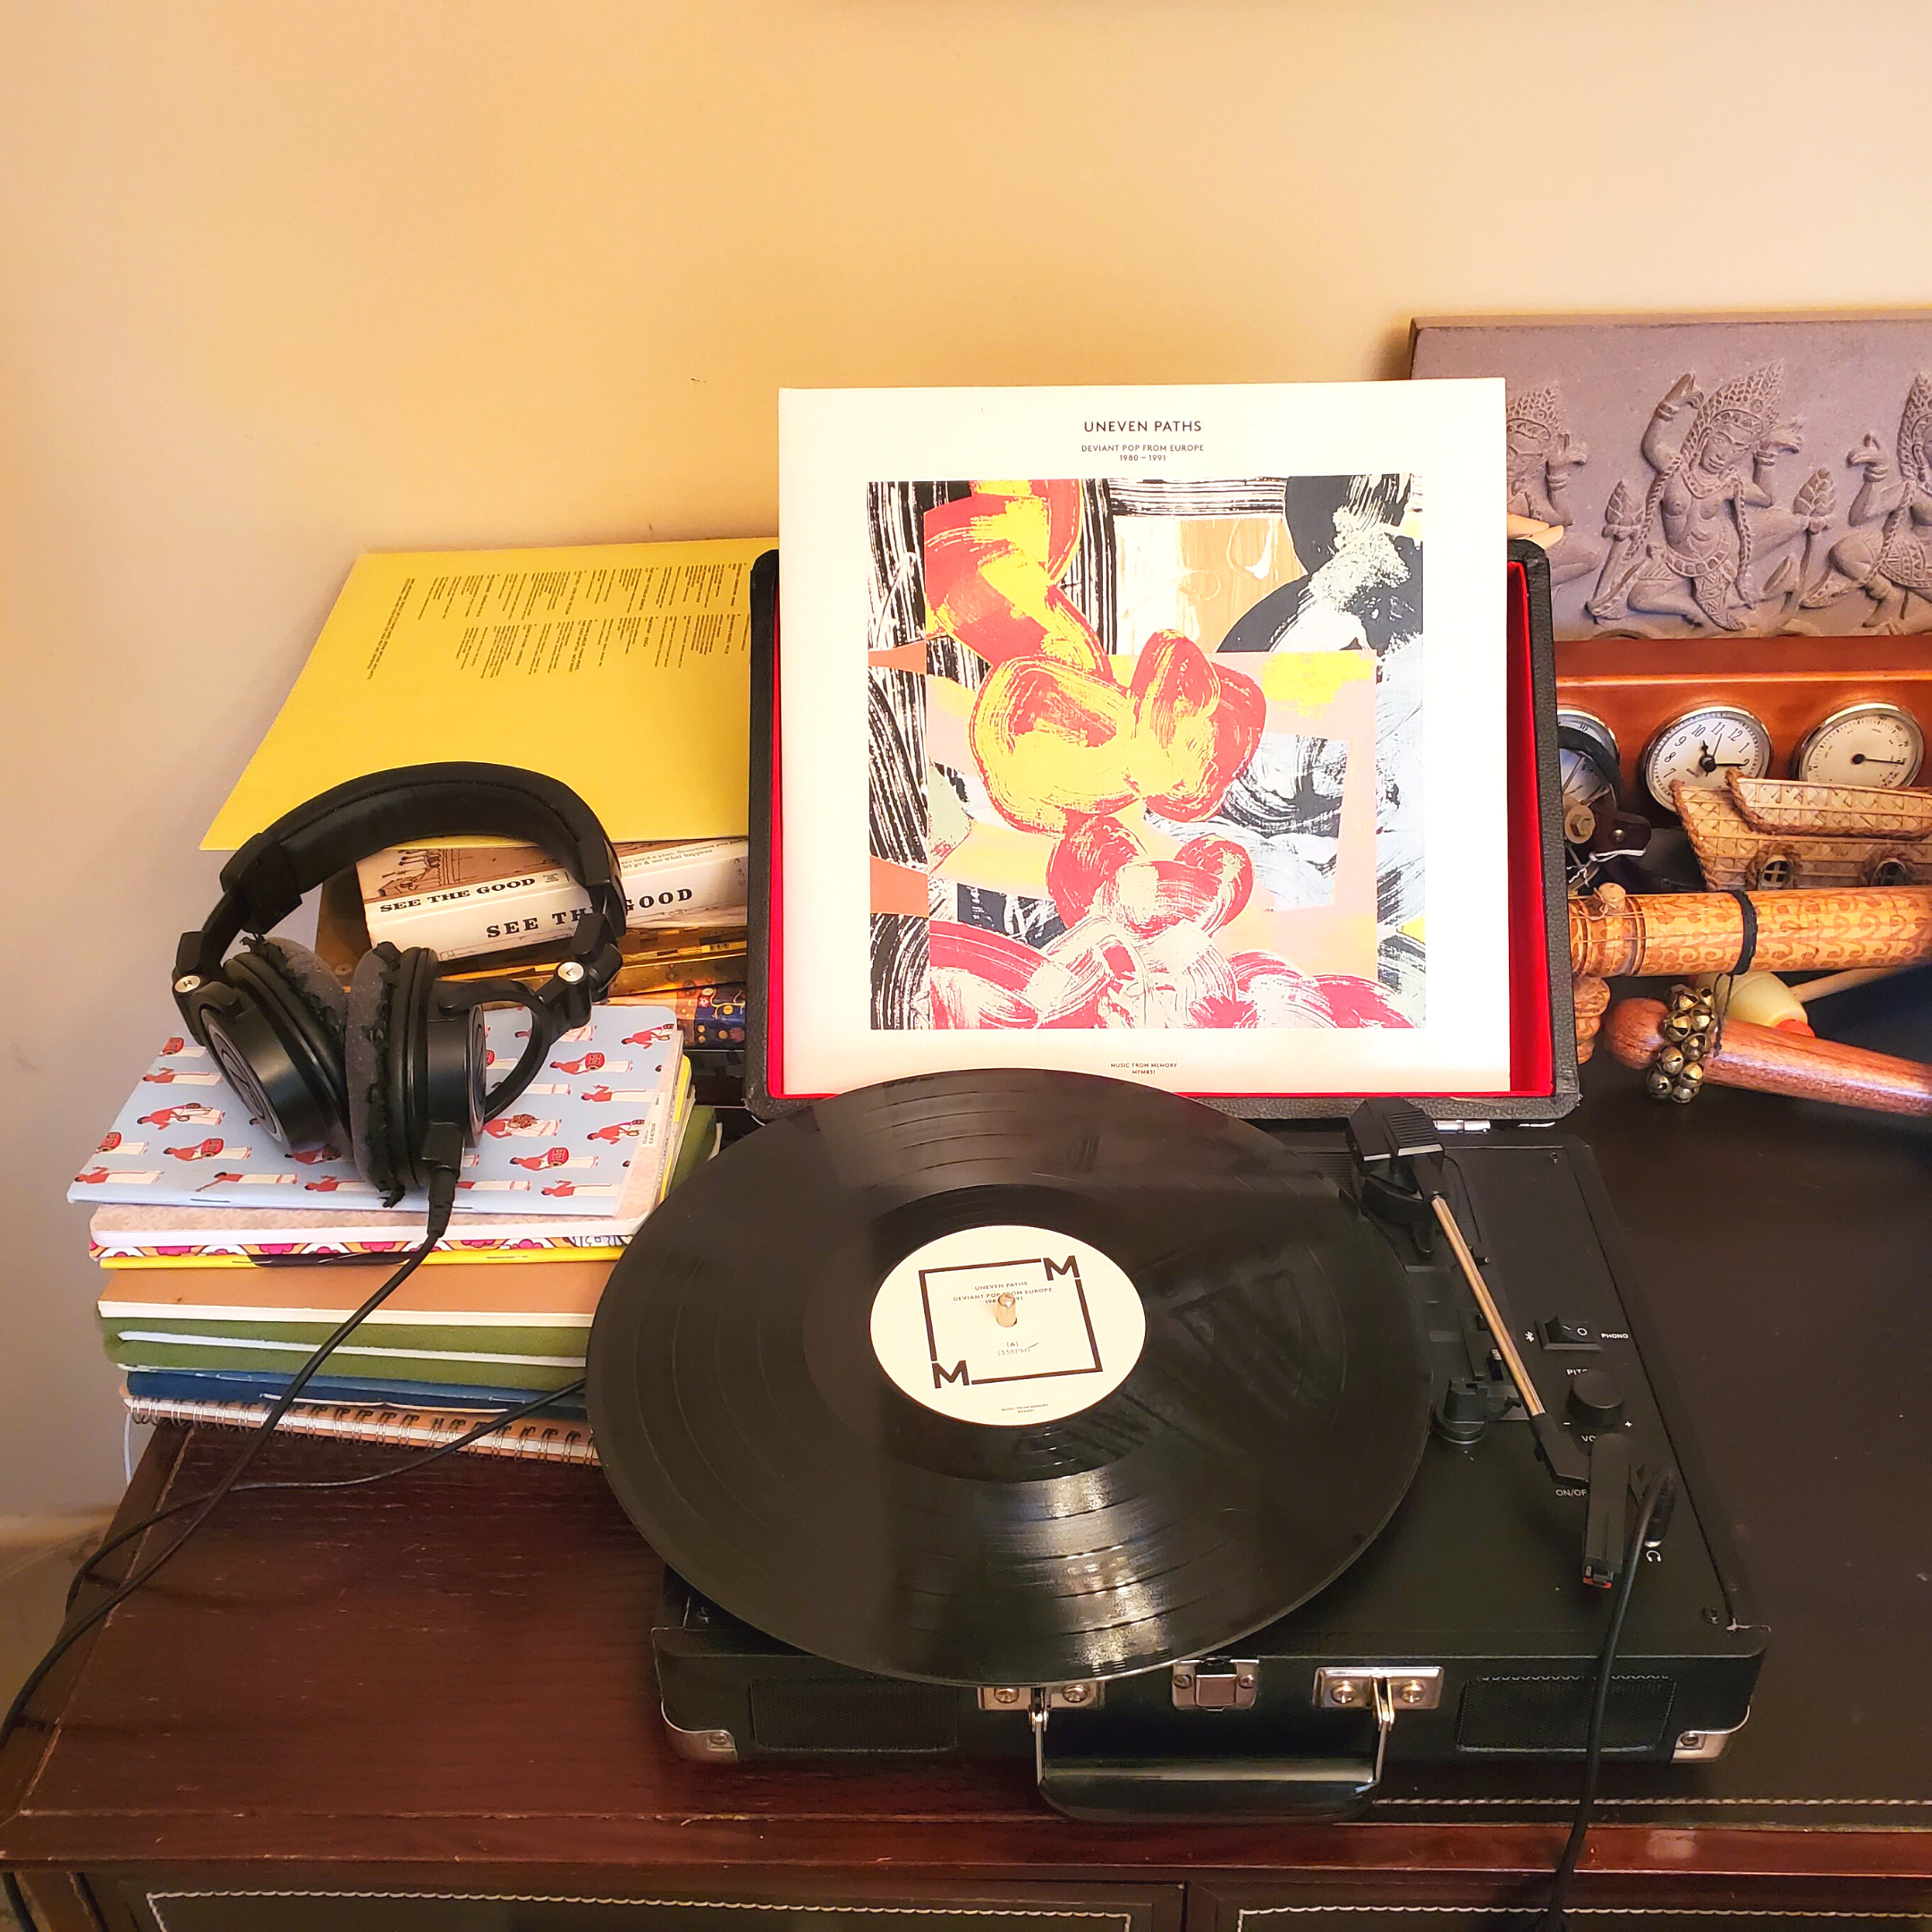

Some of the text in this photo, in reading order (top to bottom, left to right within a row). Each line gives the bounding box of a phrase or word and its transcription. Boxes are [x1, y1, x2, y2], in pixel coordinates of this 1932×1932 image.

[1083, 420, 1202, 433] UNEVEN PATHS
[1690, 724, 1707, 738] 10
[1710, 722, 1726, 736] 11
[1727, 727, 1743, 741] 12
[1674, 735, 1687, 747] 9
[1738, 741, 1750, 753] 1
[1664, 751, 1676, 763] 8
[1663, 767, 1677, 779] 7
[379, 896, 423, 914] SEE
[427, 889, 471, 904] THE
[476, 877, 536, 896] GOOD
[486, 916, 538, 939] SEE
[551, 906, 594, 927] TH
[1043, 1254, 1080, 1282] M
[953, 1293, 985, 1301] DEVIANT
[1024, 1287, 1053, 1295] EUROPE
[931, 1360, 970, 1389] M
